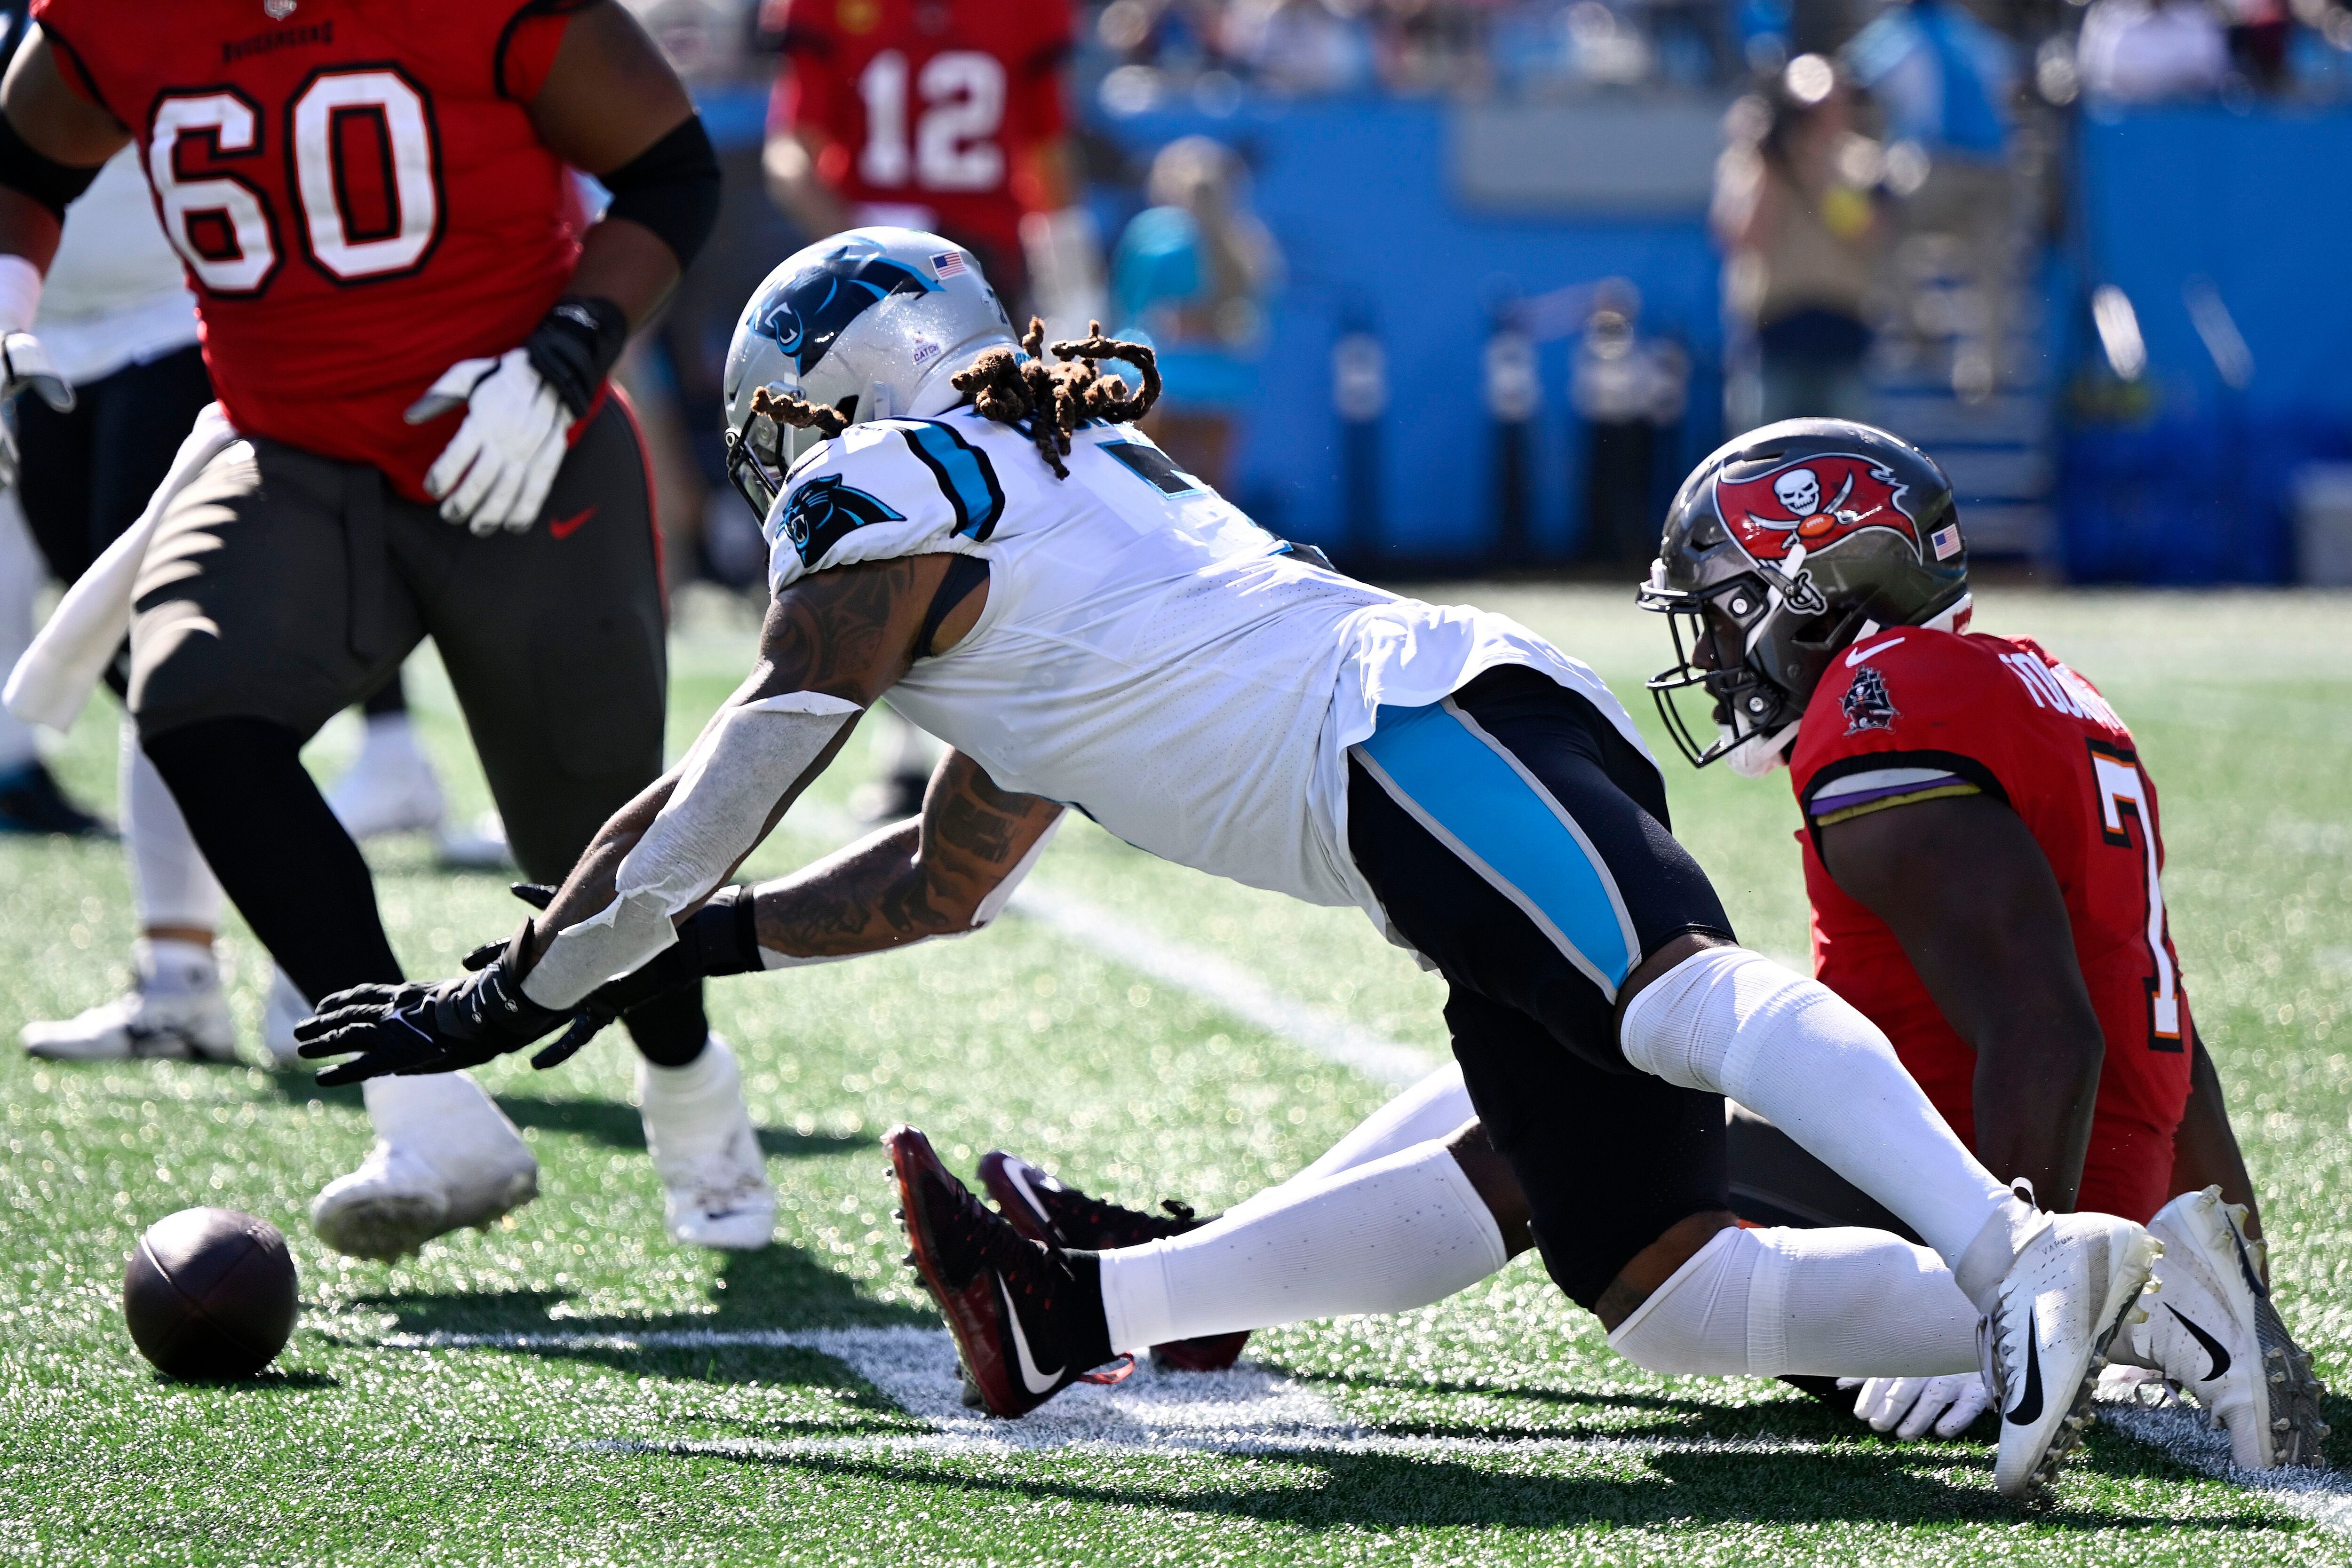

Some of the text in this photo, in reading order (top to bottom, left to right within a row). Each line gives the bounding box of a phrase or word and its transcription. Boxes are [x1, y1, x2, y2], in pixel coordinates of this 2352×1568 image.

[147, 62, 446, 300] 60
[856, 48, 1008, 192] 12
[2086, 737, 2184, 1052] 7
